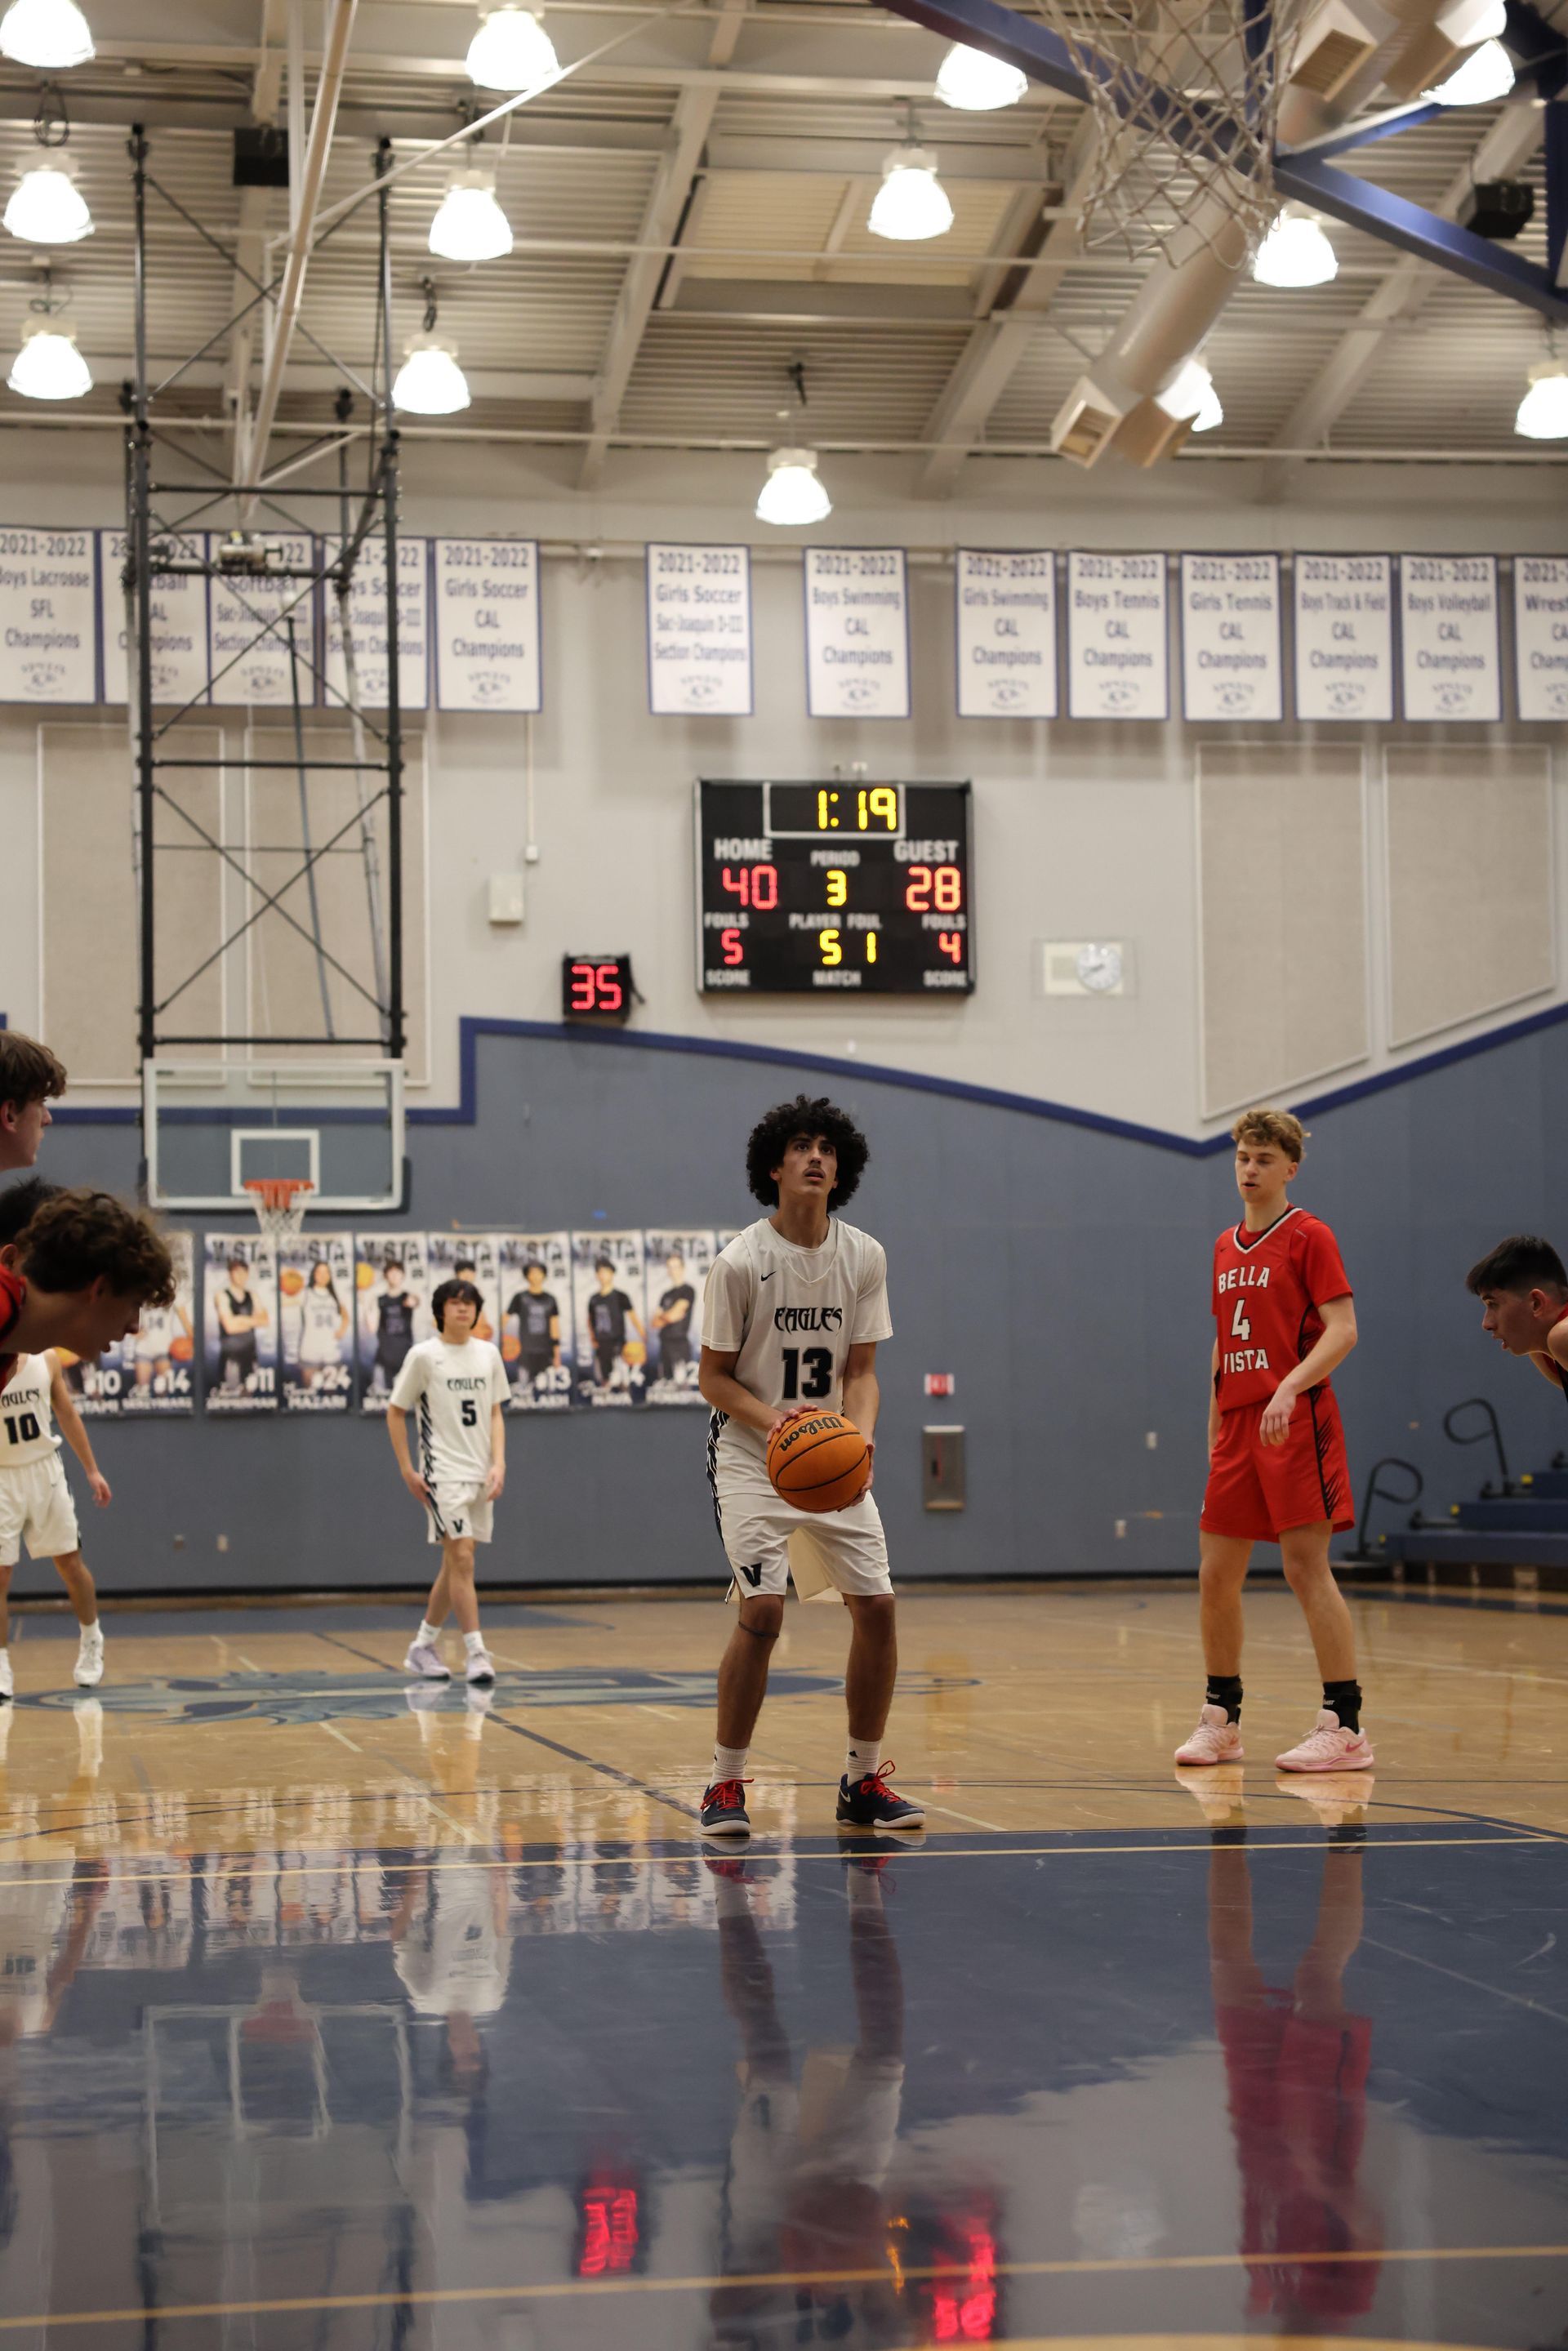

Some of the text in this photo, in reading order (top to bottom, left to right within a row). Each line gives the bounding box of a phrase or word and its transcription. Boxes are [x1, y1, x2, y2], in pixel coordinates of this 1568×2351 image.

[445, 545, 529, 568] 2021-2022
[657, 552, 741, 574] 2021-2022
[815, 554, 898, 576] 2021-2022
[967, 556, 1048, 578] 2021-2022
[1076, 557, 1159, 579] 2021-2022
[0, 566, 27, 590] oys
[1189, 559, 1271, 581] 2021-2022
[1303, 560, 1383, 581] 2021-2022
[1409, 560, 1489, 582] 2021-2022
[1523, 560, 1568, 582] 2021-
[445, 578, 528, 600] Girls Soccer
[656, 583, 742, 604] Girls Soccer
[1074, 590, 1160, 613] Boys Tennis
[1189, 592, 1273, 612] Girls Tennis
[5, 627, 80, 652] Champions
[451, 637, 525, 661] Champions
[822, 645, 893, 669] Champions
[972, 645, 1042, 670] Champions
[1083, 647, 1153, 670] Champions
[1196, 648, 1267, 672] Champions
[1309, 649, 1379, 672] Champions
[1416, 650, 1486, 672] Champions
[817, 788, 897, 830] 1:19
[714, 838, 773, 862] HOME
[810, 850, 861, 866] PERIOD
[894, 839, 960, 863] GUEST
[722, 865, 777, 910] 40
[826, 870, 847, 906] 3
[906, 866, 960, 911] 28
[704, 912, 750, 929] FOULS
[789, 913, 883, 930] PLAYER FOUL
[921, 913, 967, 931] FOULS
[721, 928, 744, 965] 5
[819, 929, 876, 965] 5 1
[939, 932, 961, 964] 4
[572, 965, 622, 1009] 35
[1218, 1265, 1271, 1294] BELLA
[774, 1307, 843, 1333] EAGLES
[1232, 1298, 1251, 1342] 4
[781, 1347, 834, 1400] 13
[461, 1400, 477, 1427] 5
[4, 1412, 41, 1445] 10
[779, 1416, 845, 1452] Wilson
[740, 1562, 763, 1588] V
